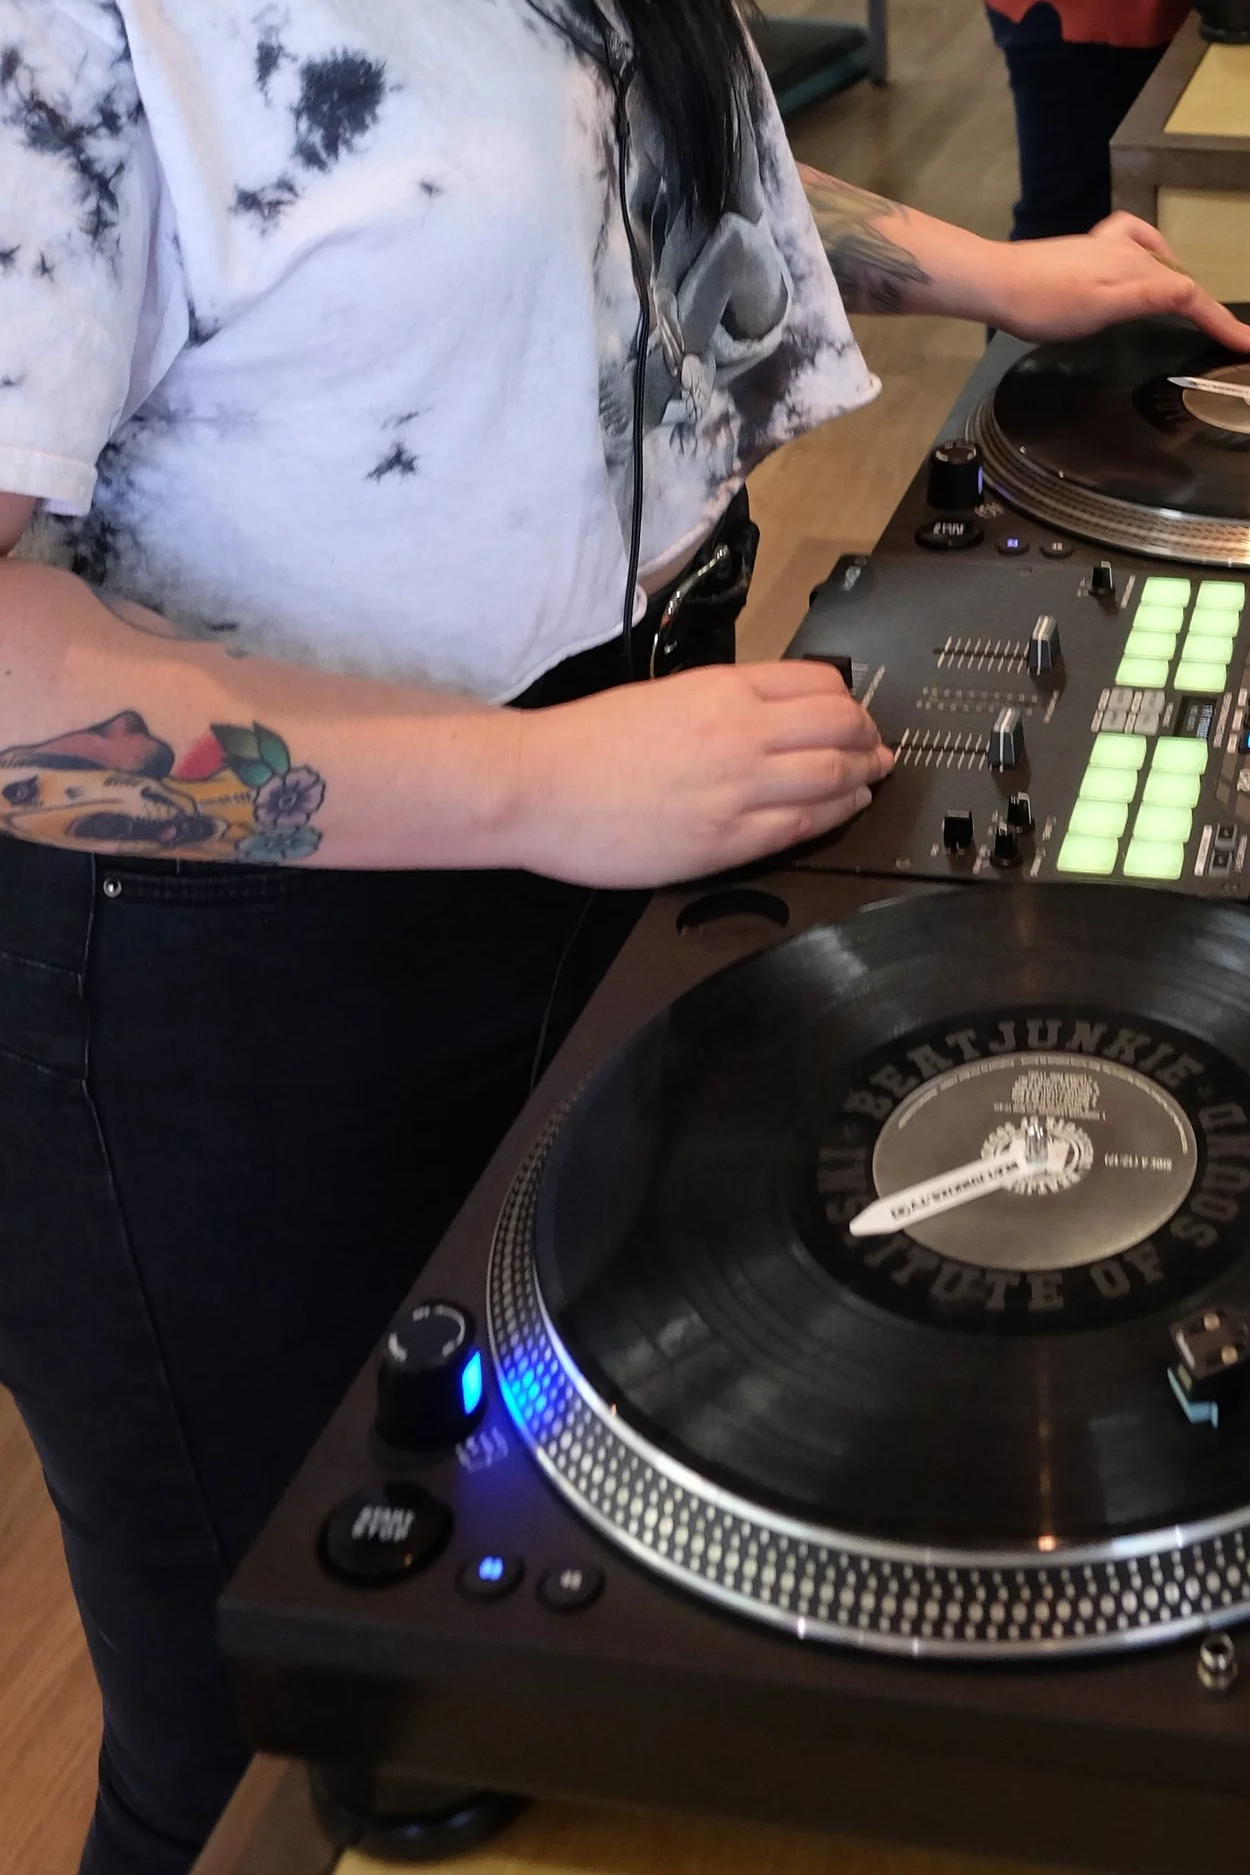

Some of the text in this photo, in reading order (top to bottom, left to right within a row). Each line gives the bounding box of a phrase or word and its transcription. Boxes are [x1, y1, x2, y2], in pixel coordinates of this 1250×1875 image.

[845, 1017, 1204, 1121] BEATJUNKIE
[817, 1146, 1064, 1312] INSITUTE
[1090, 1240, 1164, 1299] OF
